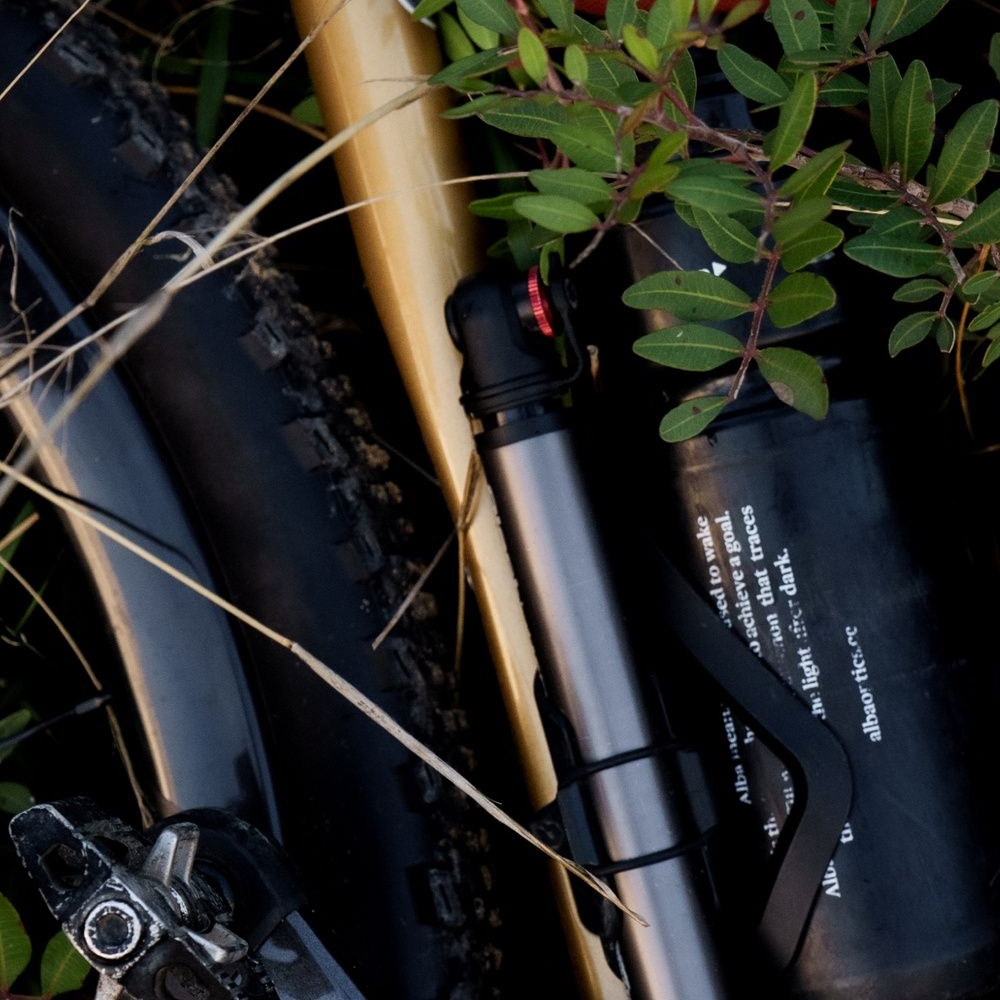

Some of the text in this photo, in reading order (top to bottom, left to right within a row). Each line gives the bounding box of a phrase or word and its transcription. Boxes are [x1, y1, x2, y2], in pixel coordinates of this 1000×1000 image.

[696, 516, 716, 563] wake
[714, 510, 742, 554] goal.
[708, 564, 723, 586] to
[728, 555, 742, 568] a
[740, 504, 775, 607] that traces
[773, 547, 798, 596] dark.
[732, 569, 759, 639] achieve
[797, 646, 820, 691] light
[735, 764, 752, 805] Alba
[822, 859, 842, 898] Alb
